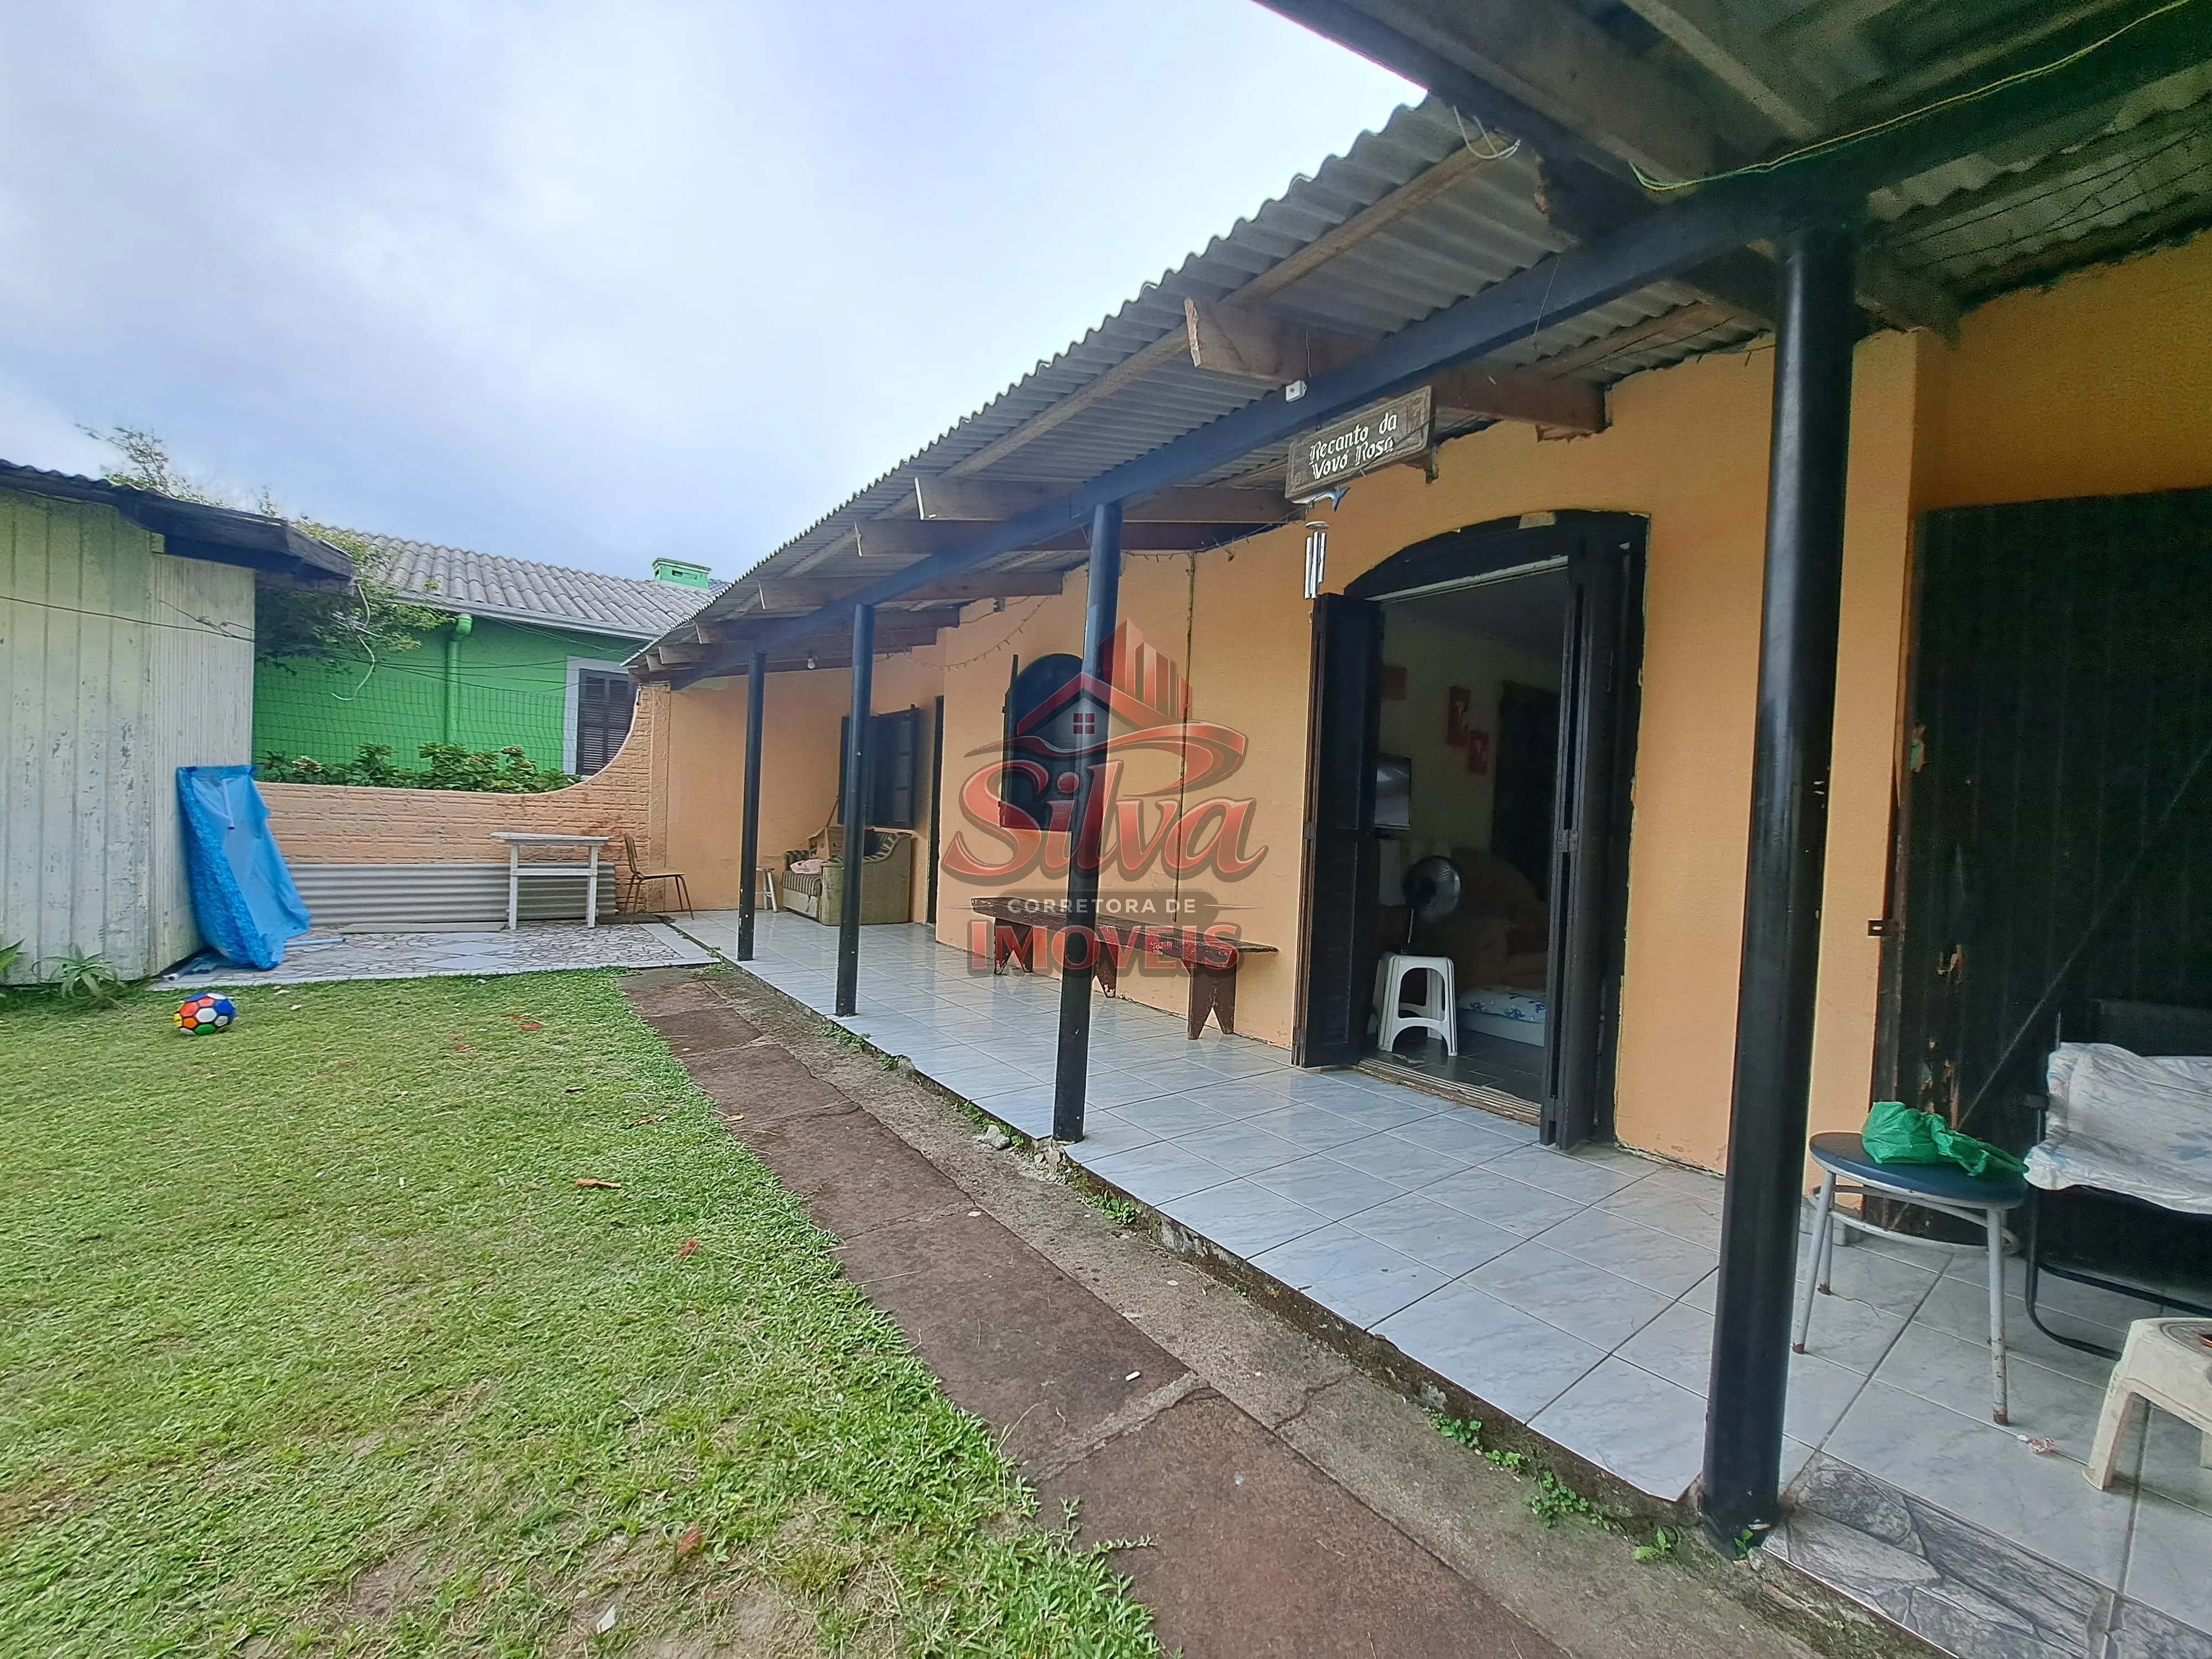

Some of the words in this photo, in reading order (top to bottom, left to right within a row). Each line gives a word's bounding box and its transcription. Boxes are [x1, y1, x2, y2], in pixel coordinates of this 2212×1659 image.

[1310, 424, 1369, 465] Recanto
[1379, 413, 1397, 435] da
[1355, 436, 1394, 466] Rosa
